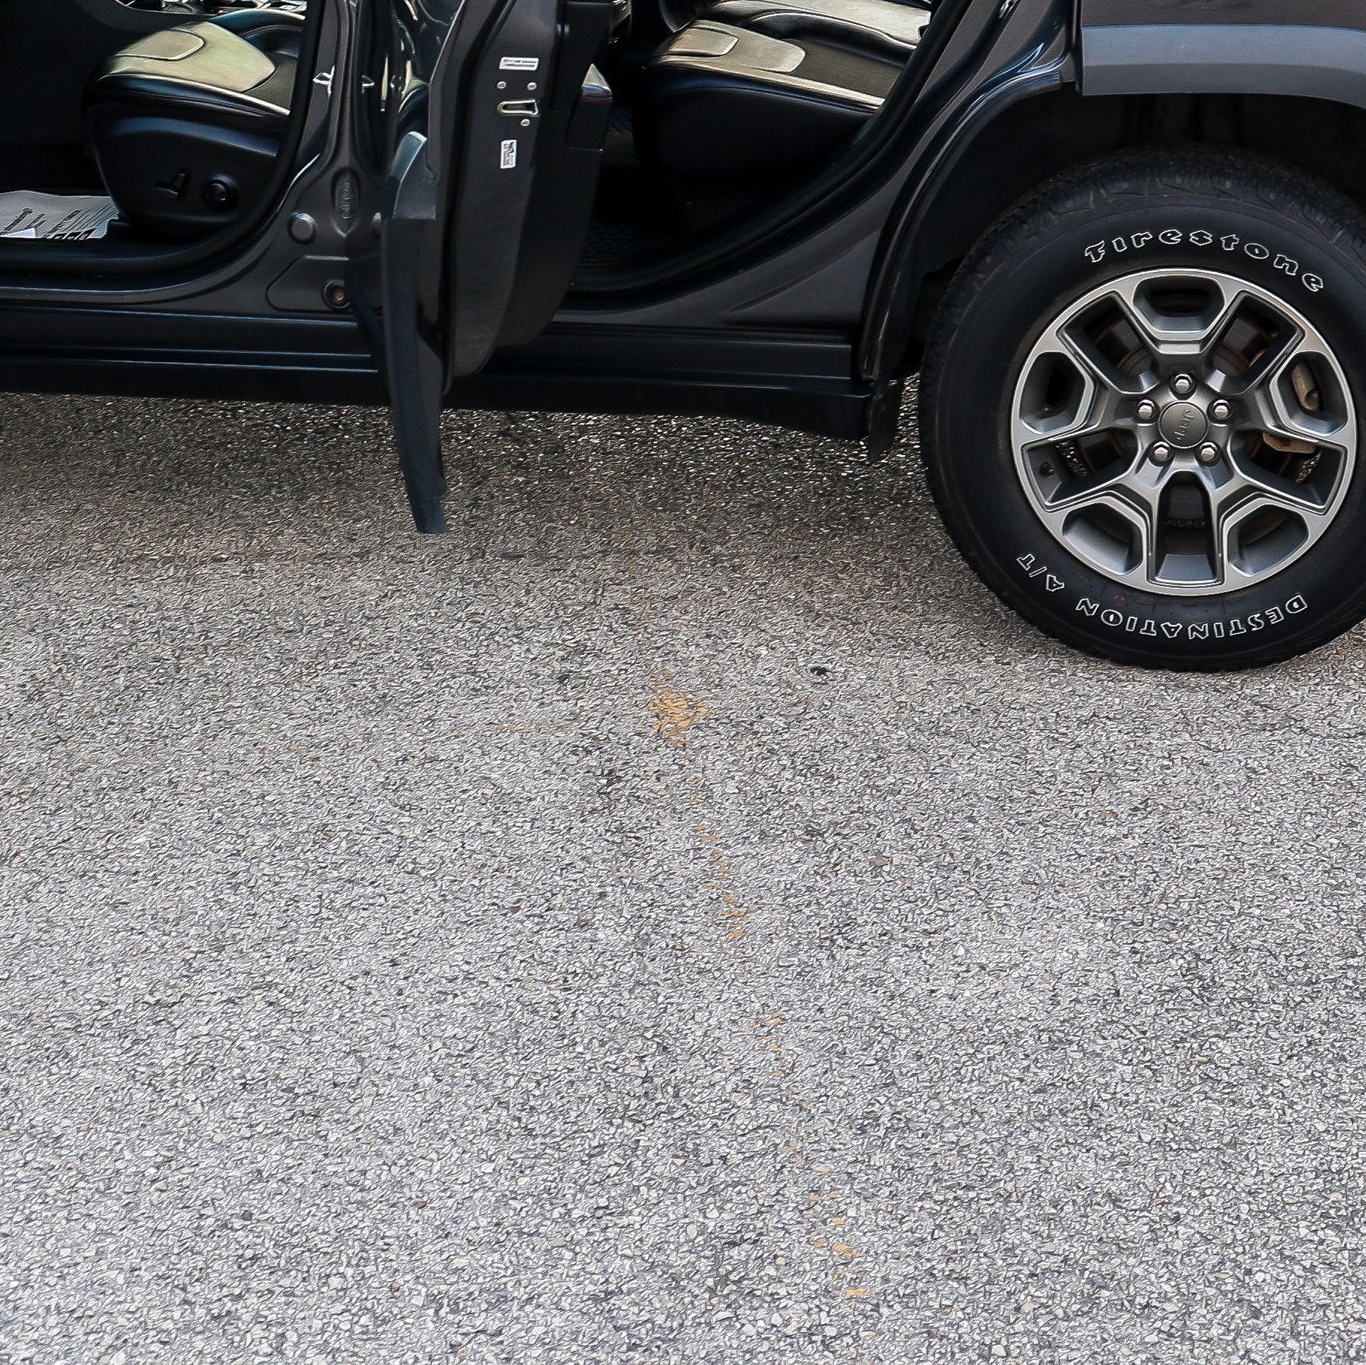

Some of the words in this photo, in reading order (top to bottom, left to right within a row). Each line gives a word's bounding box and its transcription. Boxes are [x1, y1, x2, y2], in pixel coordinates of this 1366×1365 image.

[1084, 229, 1324, 292] Firestone
[1174, 409, 1196, 441] Jeep
[1016, 553, 1065, 592] A/T
[1075, 595, 1308, 640] DESTINATION
